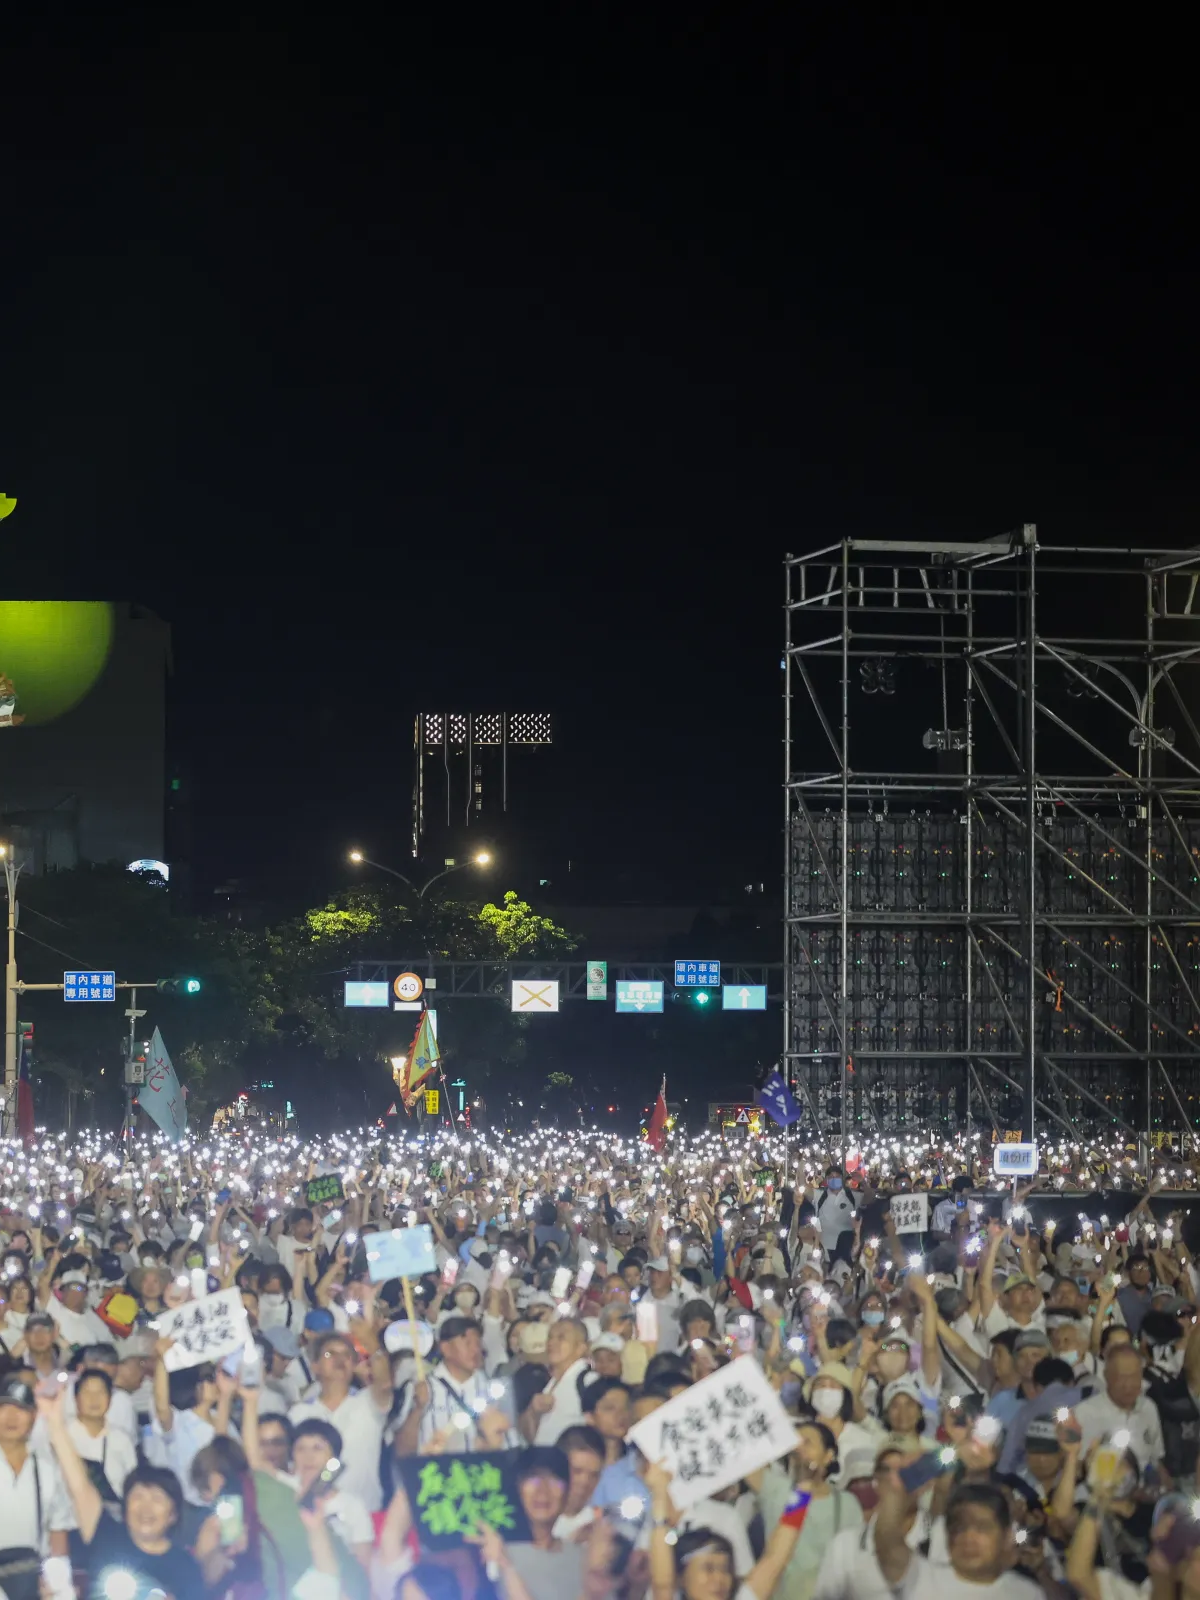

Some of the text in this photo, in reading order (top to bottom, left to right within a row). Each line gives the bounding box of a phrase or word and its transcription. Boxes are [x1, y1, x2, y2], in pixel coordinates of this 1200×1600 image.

[676, 963, 719, 973] 環內車道
[66, 974, 113, 986] 環內車道
[676, 974, 719, 984] 專用號誌
[401, 983, 416, 992] 40
[66, 988, 113, 999] 專用號誌
